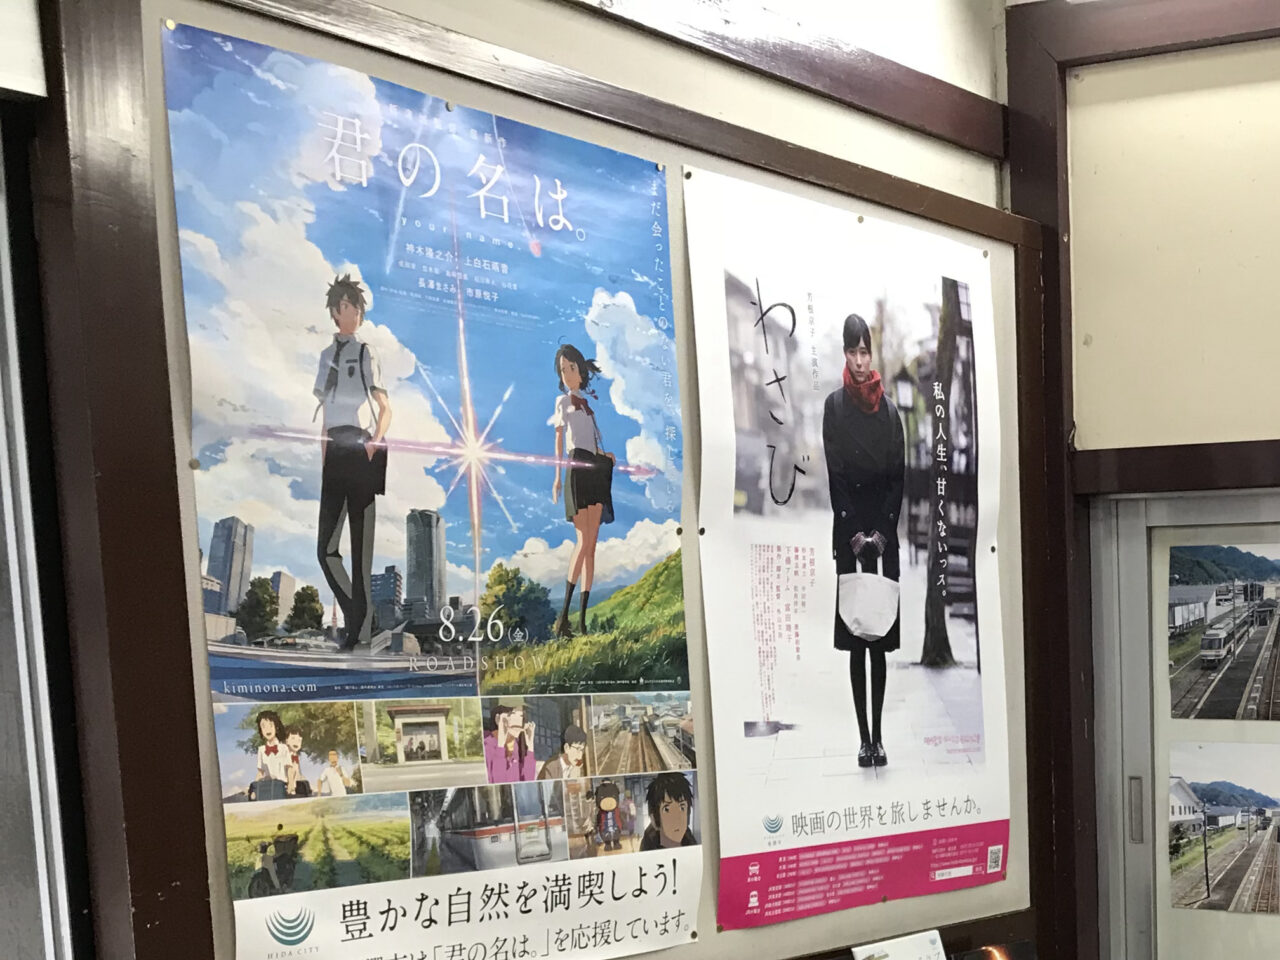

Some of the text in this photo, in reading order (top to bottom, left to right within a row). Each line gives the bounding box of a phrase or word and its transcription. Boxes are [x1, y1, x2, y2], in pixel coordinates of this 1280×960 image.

[317, 110, 586, 242] 君の名は。
[401, 216, 448, 233] your
[223, 681, 317, 695] kiminona.com
[791, 796, 982, 838] 映画の世界を旅しませんか。
[267, 946, 320, 959] HIDA CITY
